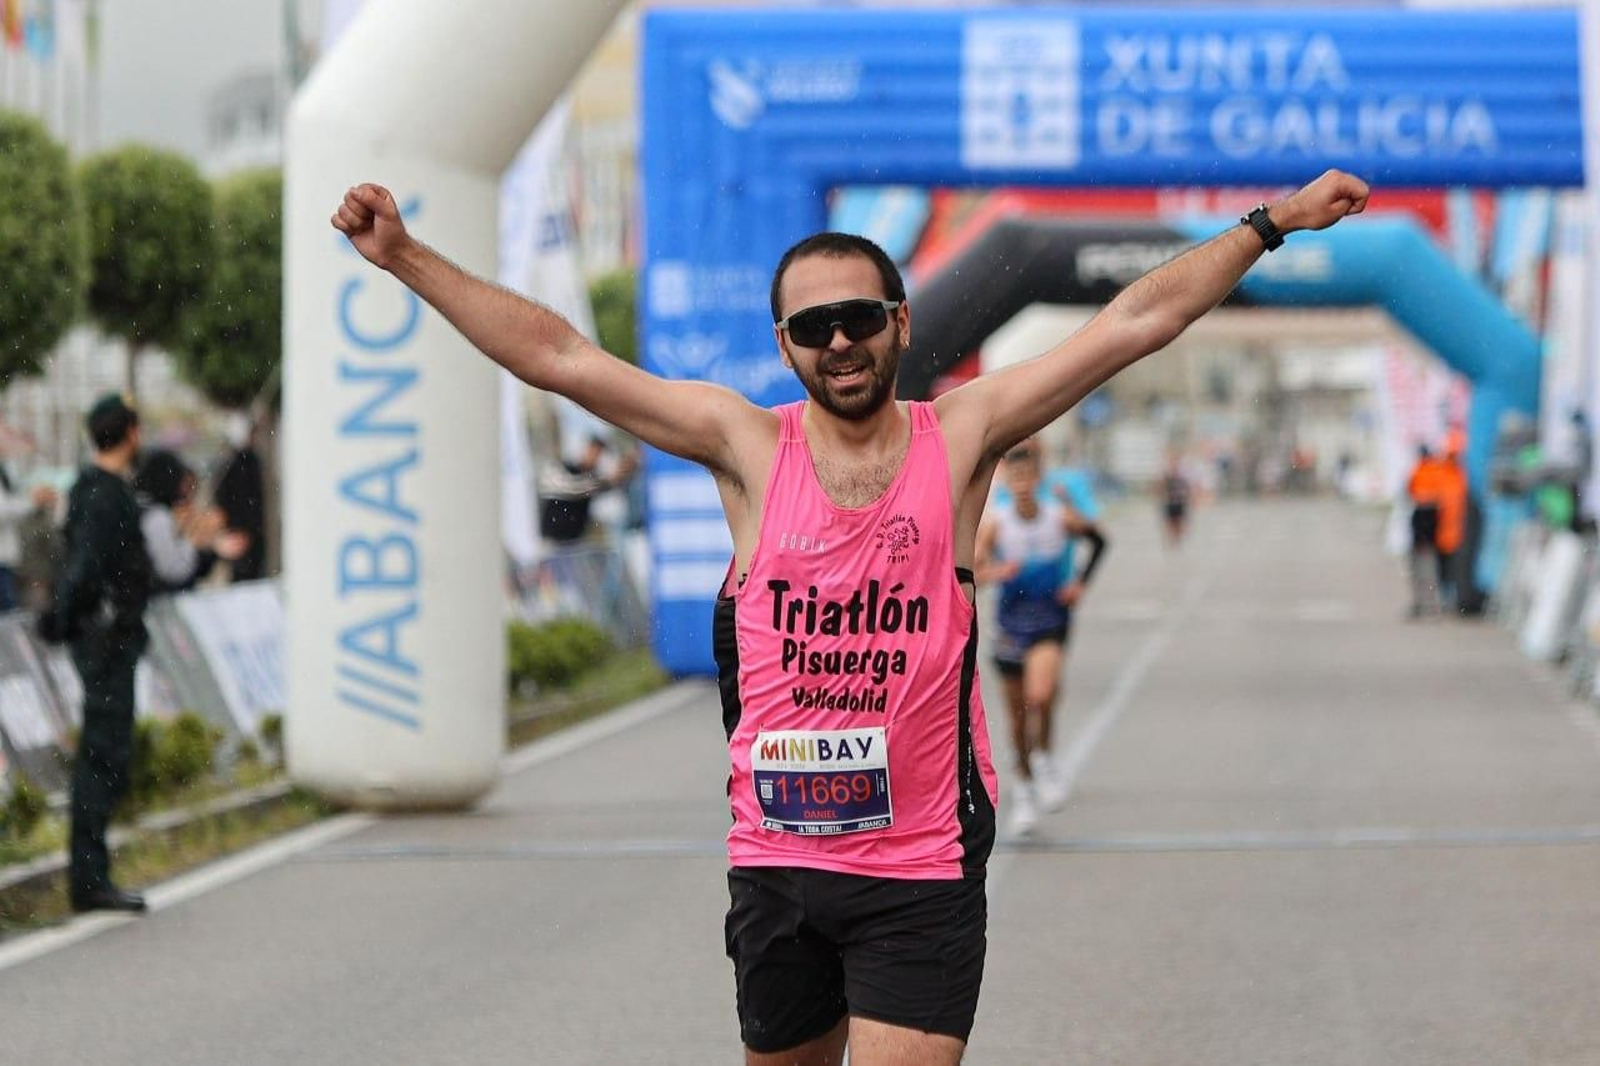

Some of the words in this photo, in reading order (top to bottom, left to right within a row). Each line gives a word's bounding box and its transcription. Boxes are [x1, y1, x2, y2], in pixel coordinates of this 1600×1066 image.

[1101, 34, 1348, 91] XUNTA
[1098, 101, 1190, 156] DE
[1209, 99, 1497, 156] GALICIA
[767, 579, 929, 636] Triatlón
[781, 638, 907, 685] Pisuerga
[792, 686, 888, 713] Valladolid
[760, 737, 873, 761] MINIBAY
[776, 774, 872, 804] 11669
[803, 809, 838, 820] DANIEL
